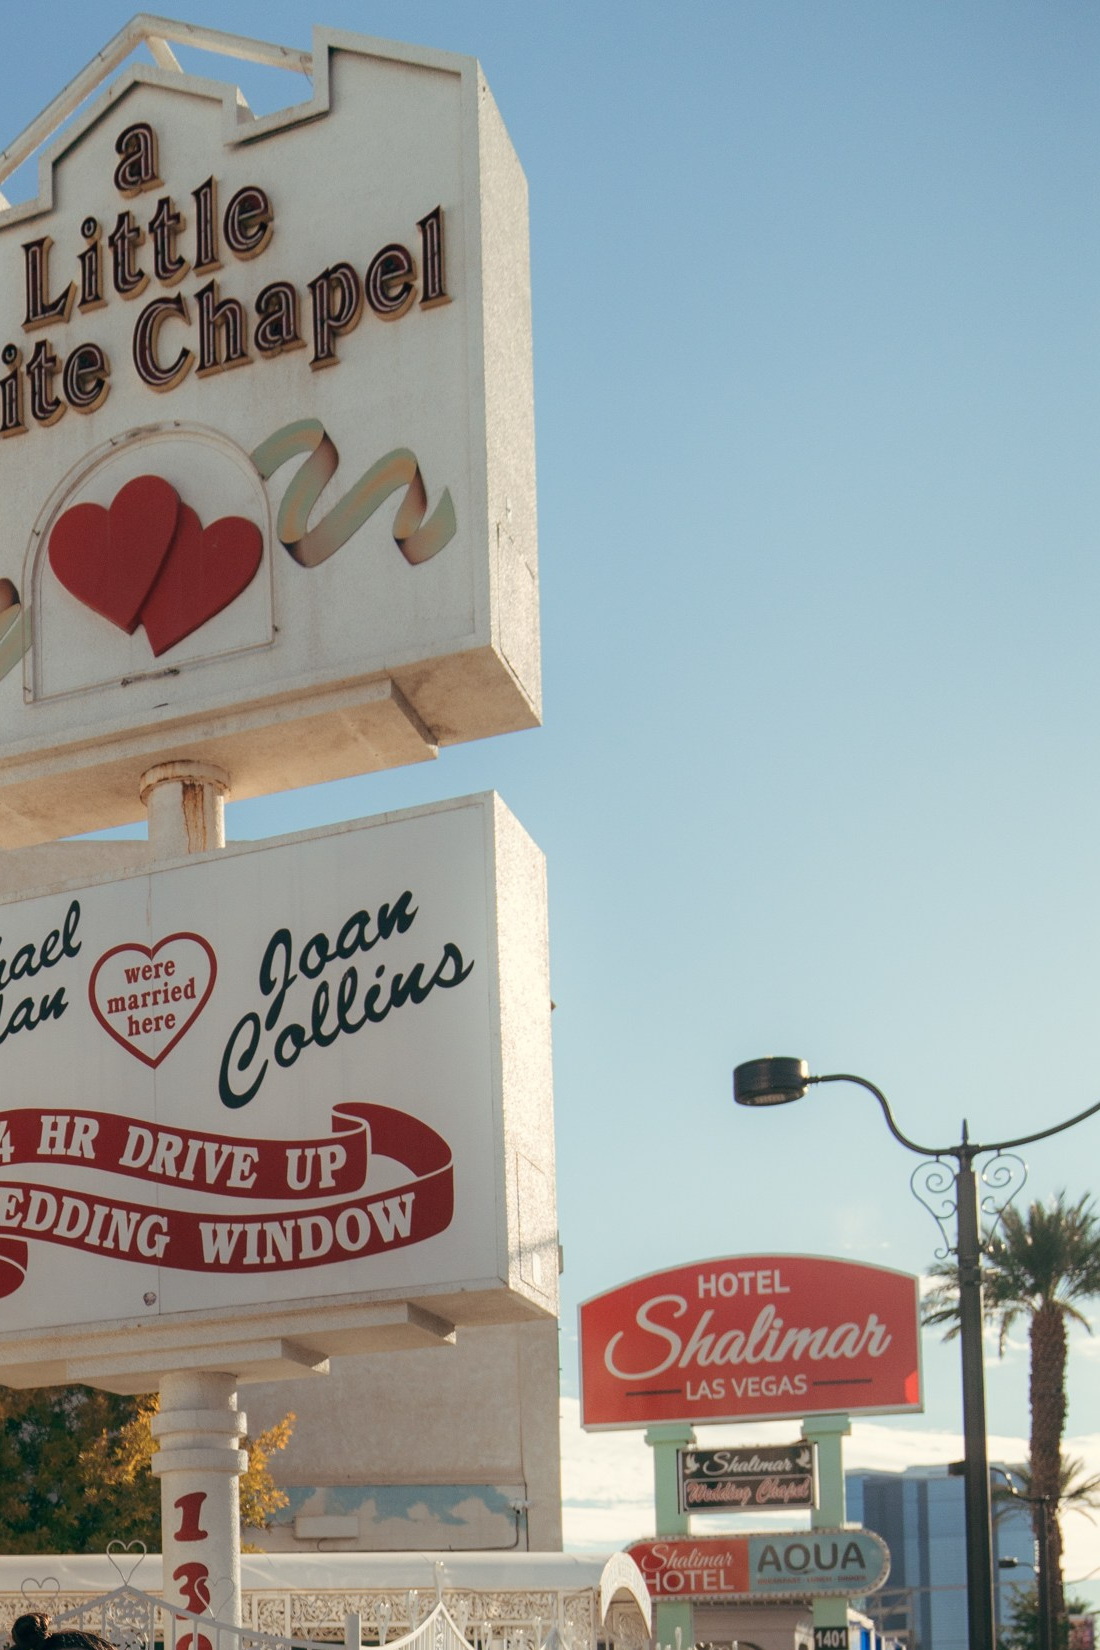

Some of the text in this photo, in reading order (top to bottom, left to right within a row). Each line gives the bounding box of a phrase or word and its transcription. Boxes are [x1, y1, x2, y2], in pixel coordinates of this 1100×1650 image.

[114, 122, 164, 198] a
[22, 175, 274, 333] Little
[132, 204, 453, 393] Chapel
[124, 959, 176, 985] were
[259, 890, 419, 1031] Joan
[106, 977, 197, 1014] married
[127, 1013, 176, 1037] here
[218, 942, 475, 1109] Collins
[37, 1115, 100, 1159] HR
[119, 1125, 260, 1189] DRIVE
[286, 1144, 348, 1190] UP
[200, 1192, 416, 1266] WINDOW
[697, 1269, 791, 1298] HOTEL
[604, 1294, 892, 1380] Shalimar
[686, 1374, 808, 1400] LAS VEGAS
[702, 1451, 793, 1476] Shalimar
[641, 1543, 734, 1573] Shalimar
[757, 1542, 867, 1575] AQUA
[643, 1569, 734, 1592] HOTEL
[814, 1629, 847, 1648] 1401
